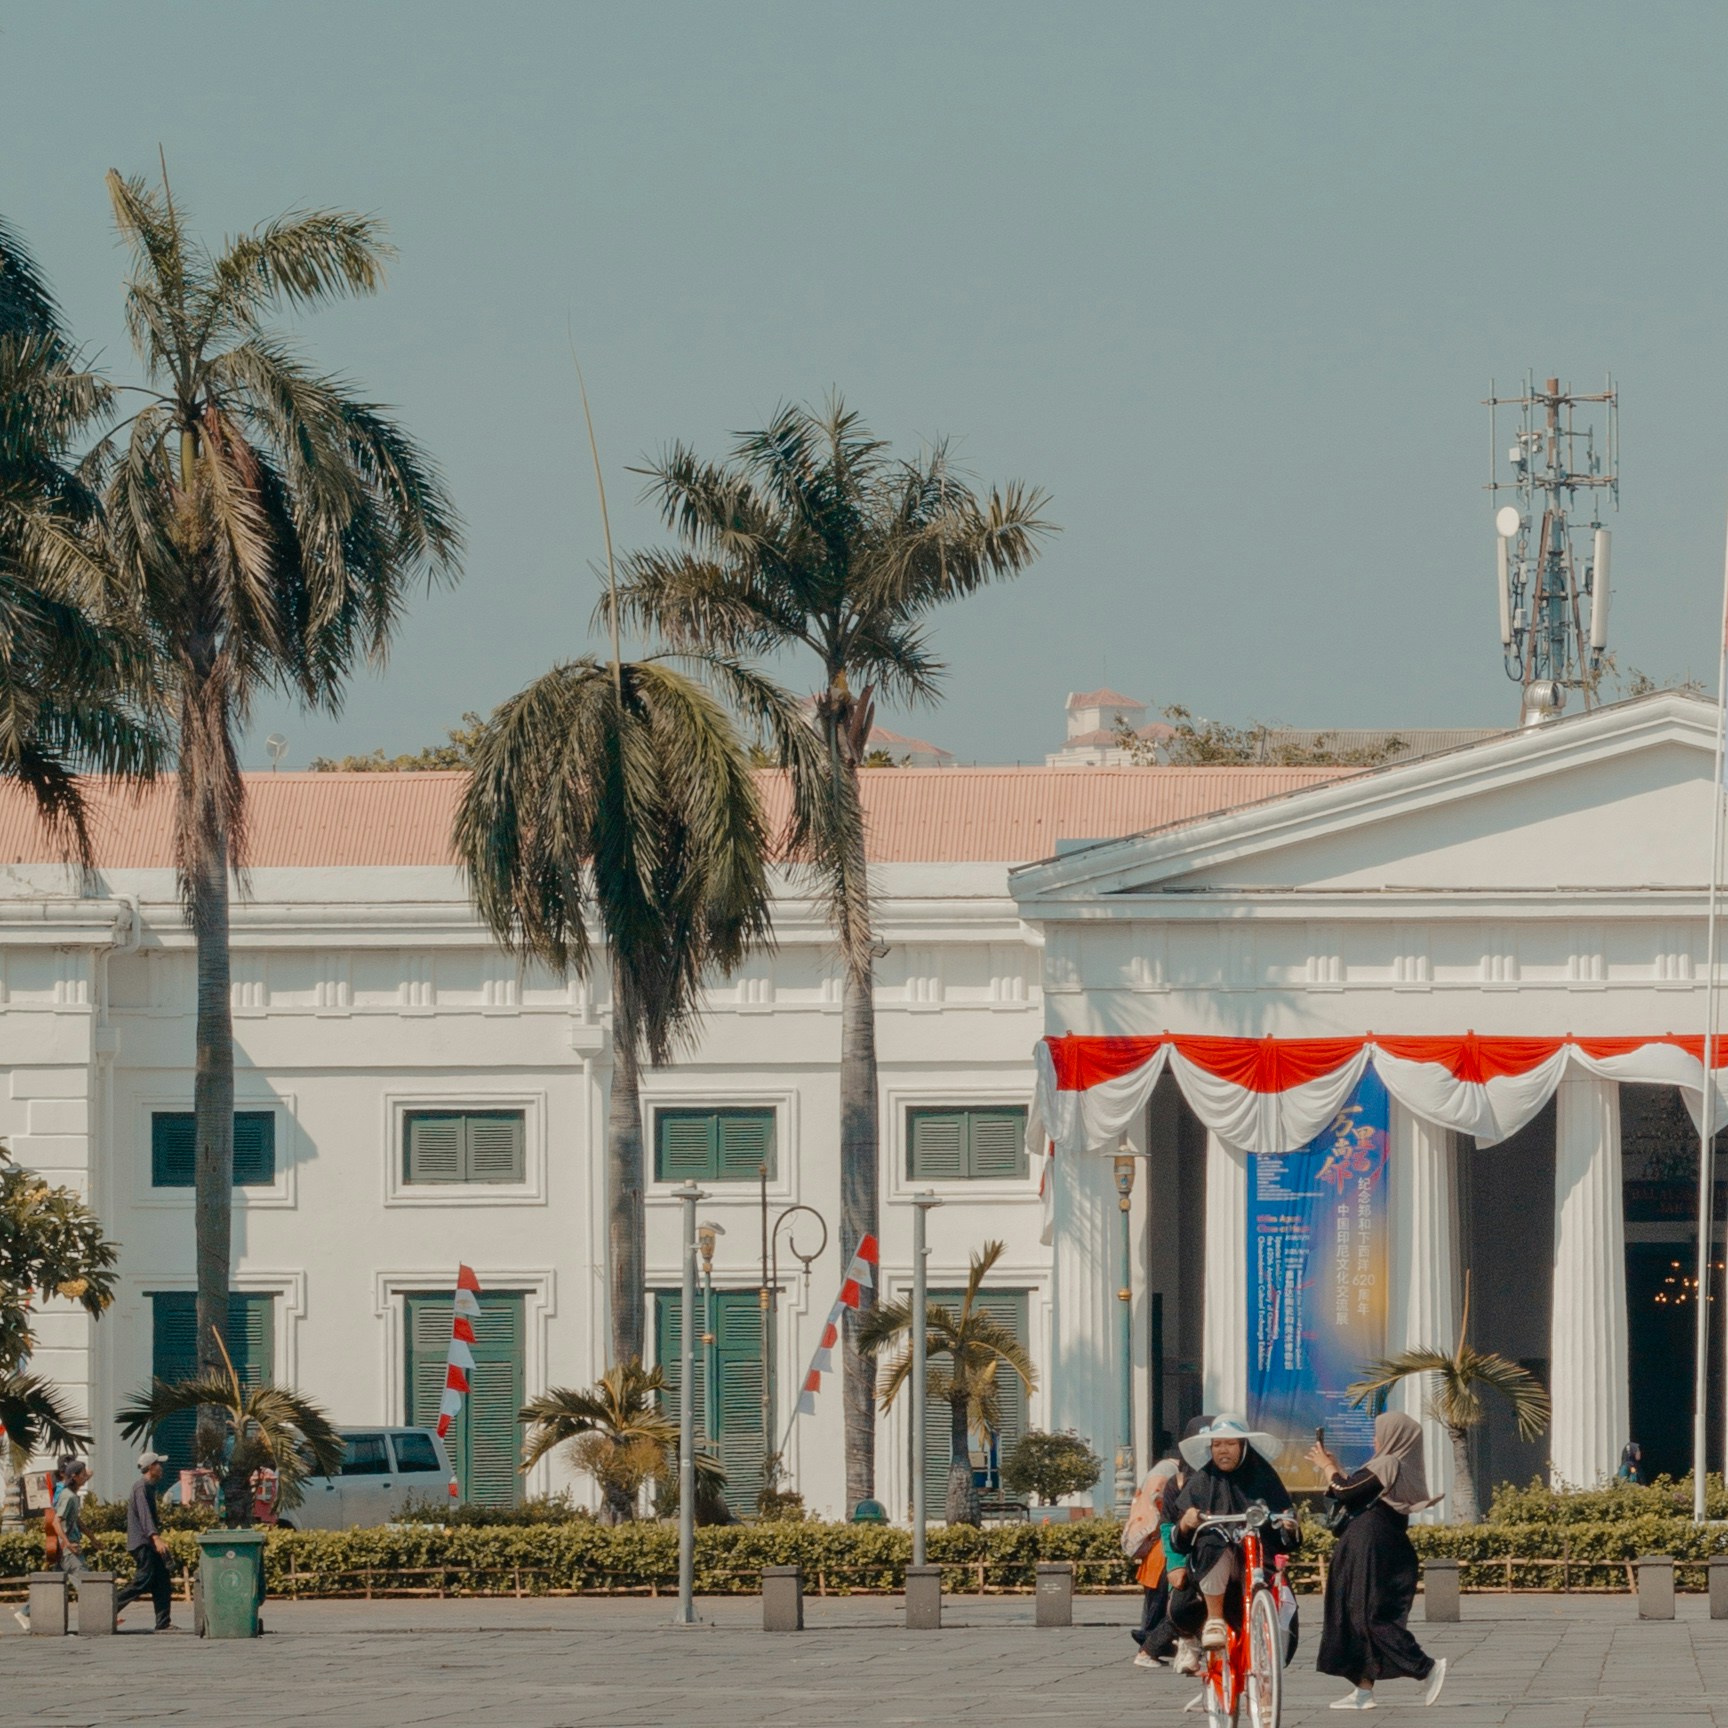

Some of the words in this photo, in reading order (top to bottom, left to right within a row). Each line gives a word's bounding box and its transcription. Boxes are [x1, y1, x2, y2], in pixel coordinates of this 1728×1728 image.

[1336, 1203, 1350, 1325] 中国印尼文化交流展
